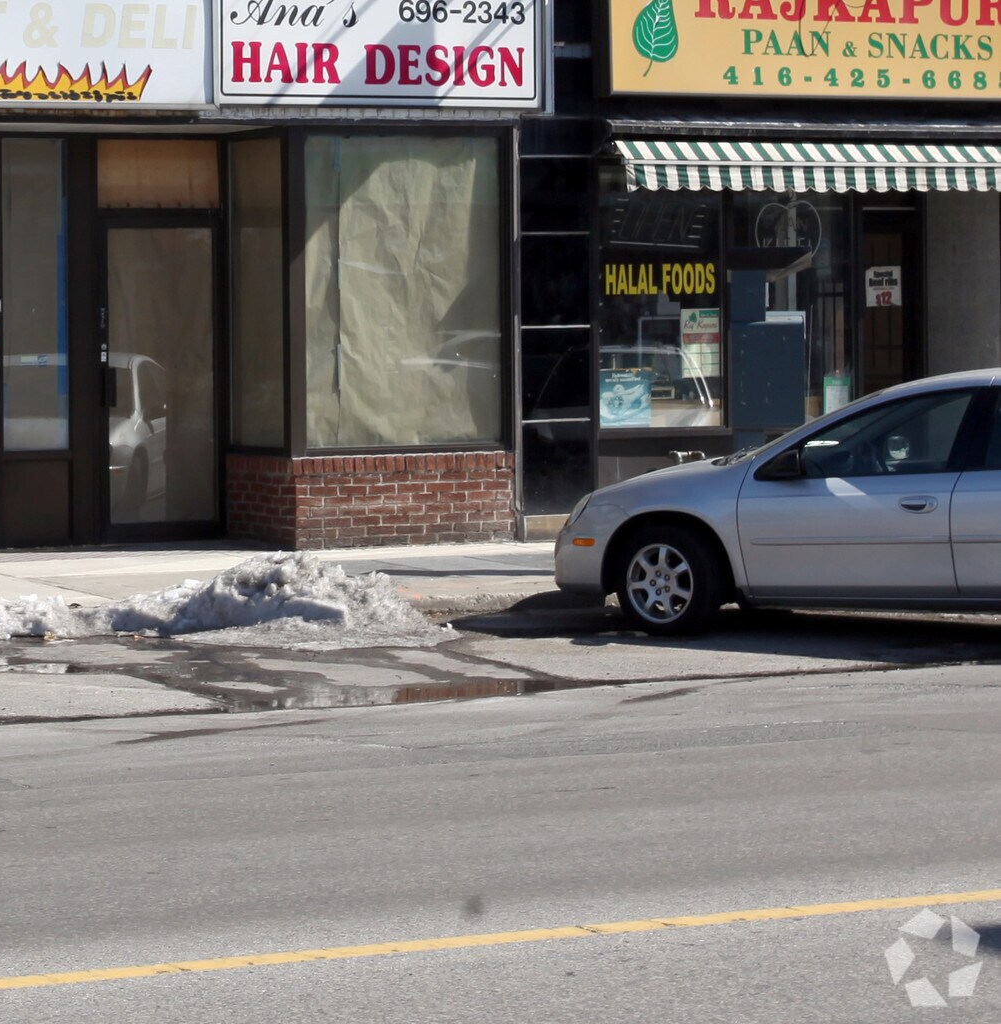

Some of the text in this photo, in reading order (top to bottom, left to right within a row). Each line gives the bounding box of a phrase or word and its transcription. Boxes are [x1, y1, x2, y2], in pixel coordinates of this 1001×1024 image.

[22, 2, 60, 48] &
[80, 3, 198, 50] DELI
[741, 28, 994, 62] PAAN & SNACKS
[231, 41, 525, 87] HAIR DESIGN
[722, 66, 1001, 91] 416-425-668
[605, 262, 716, 296] HALAL FOODS
